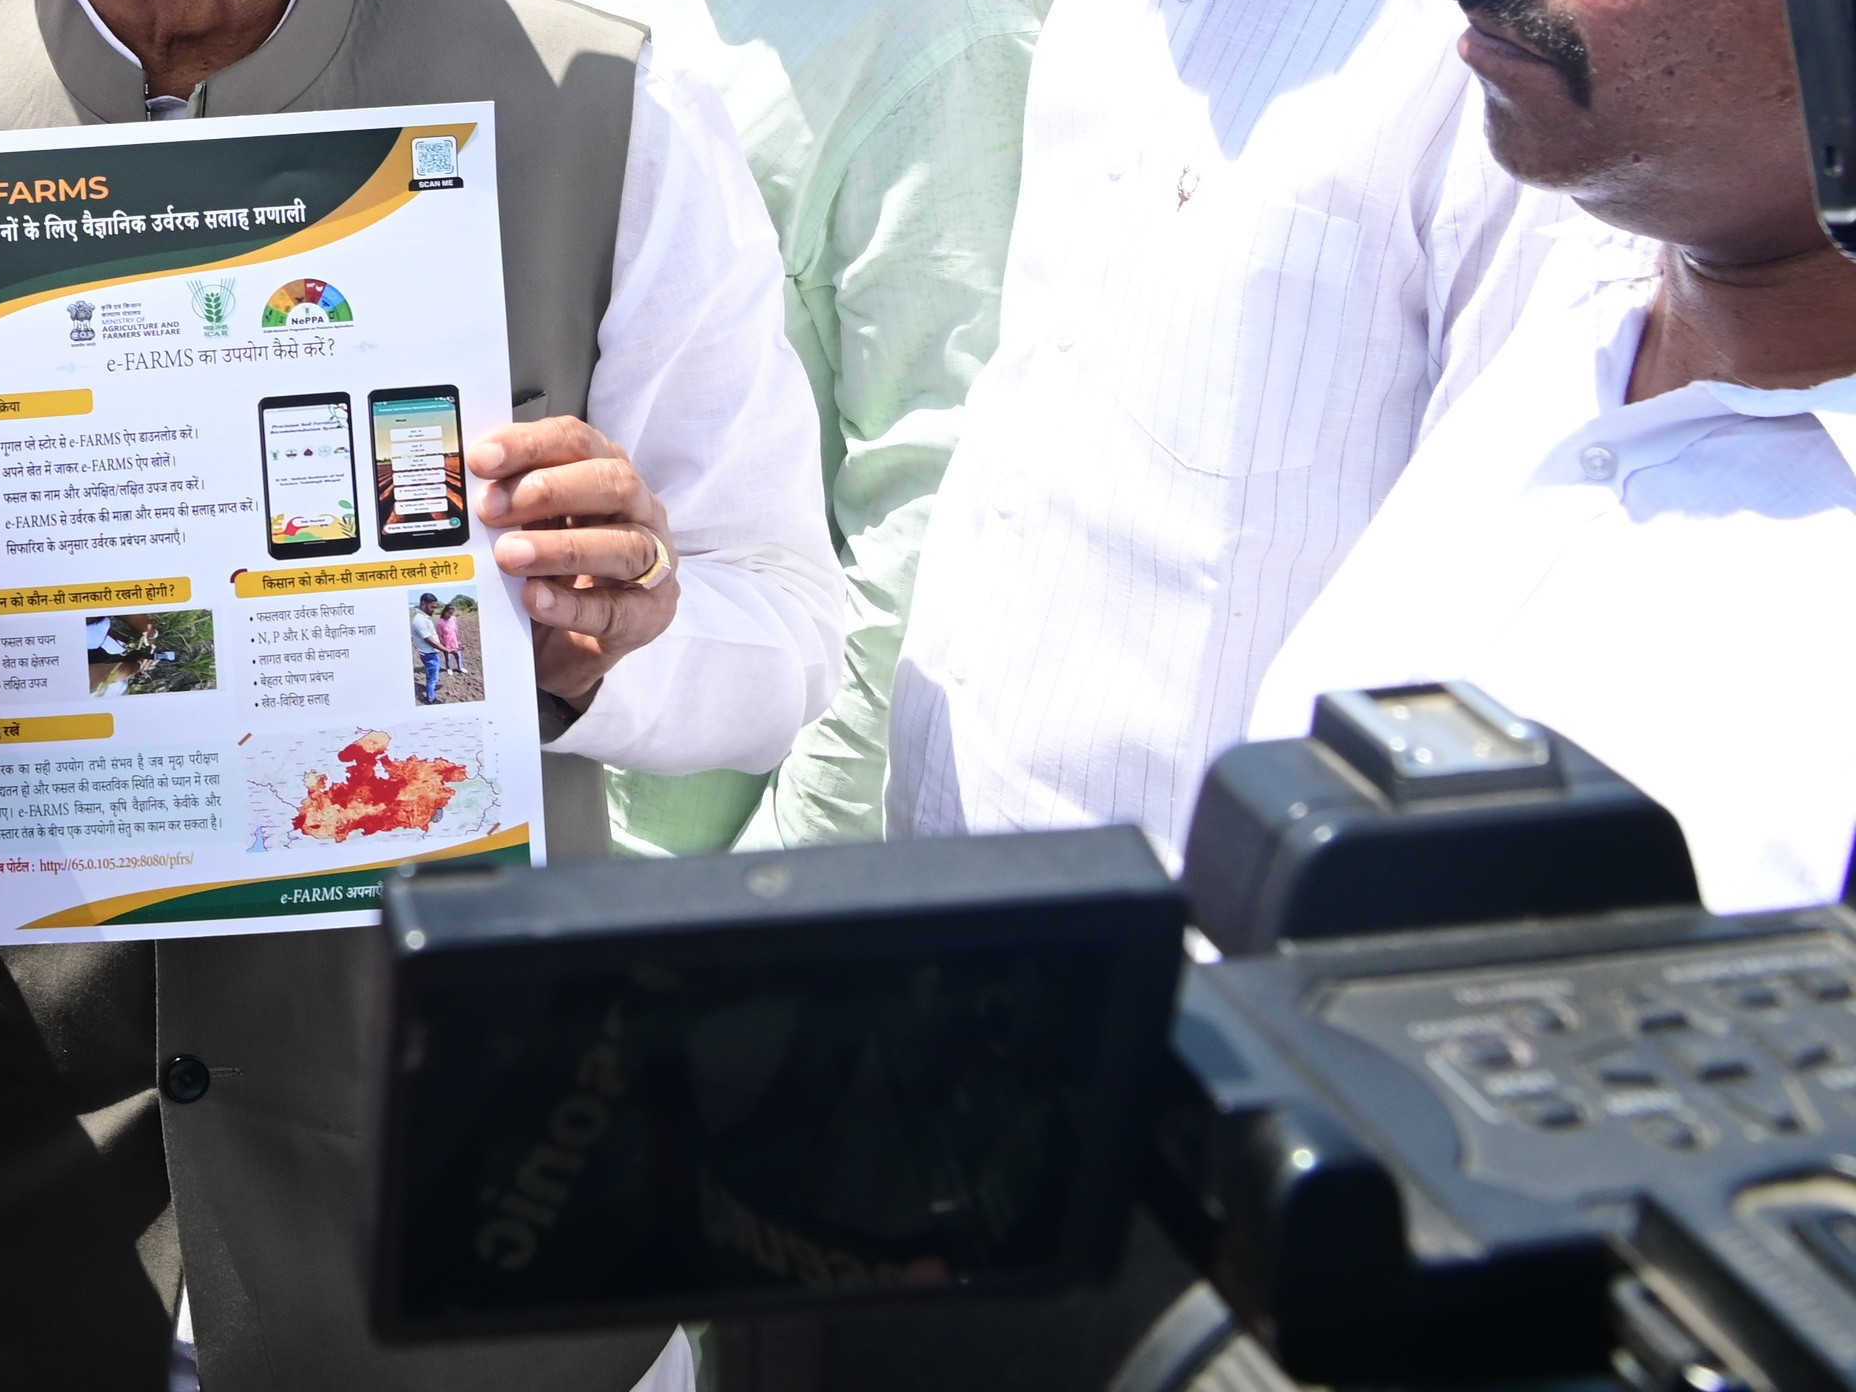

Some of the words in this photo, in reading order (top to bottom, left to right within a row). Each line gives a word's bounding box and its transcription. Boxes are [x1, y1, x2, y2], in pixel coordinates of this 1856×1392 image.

[418, 180, 441, 188] SCAN
[22, 214, 40, 240] के
[43, 213, 78, 241] लिए
[80, 209, 146, 239] वैज्ञानिक
[149, 204, 199, 232] उर्वरक
[202, 208, 250, 231] सलाह
[252, 197, 306, 225] प्रणाली
[101, 316, 135, 325] MINISTRY
[101, 322, 159, 332] AGRICULTURE
[160, 320, 180, 328] AND
[291, 315, 324, 325] NePPA
[102, 330, 141, 340] FARMERS
[142, 327, 181, 337] WELFARE
[203, 329, 229, 338] ICAR
[106, 347, 194, 372] e-FARMS
[196, 349, 217, 365] का
[219, 340, 269, 363] उपयोग
[271, 337, 300, 359] कैसे
[301, 335, 335, 357] करें?
[0, 440, 23, 457] गूगल
[22, 435, 36, 451] प्ले
[36, 434, 57, 451] स्टोर
[57, 433, 67, 449] से
[68, 431, 121, 448] e-FARMS
[122, 428, 137, 447] ऐप
[137, 425, 177, 443] डाउनलोड
[1, 461, 25, 478] अपने
[25, 460, 42, 476] खेत
[42, 459, 52, 475] में
[52, 462, 79, 474] जाकर
[80, 456, 133, 473] e-FARMS
[133, 453, 149, 471] ऐप
[2, 491, 28, 504] फसल
[28, 490, 42, 502] का
[42, 489, 61, 501] नाम
[62, 482, 80, 499] और
[81, 479, 145, 500] अपेक्षित/लक्षित
[145, 481, 168, 493] उपज
[168, 480, 183, 492] तय
[4, 513, 57, 529] e-FARMS
[58, 509, 68, 526] से
[68, 508, 96, 525] उर्वरक
[96, 506, 110, 523] की
[134, 503, 153, 520] और
[152, 506, 176, 519] समय
[176, 501, 189, 517] की
[190, 503, 216, 517] सलाह
[216, 502, 238, 514] प्राप्त
[5, 538, 45, 555] सिफारिश
[45, 536, 56, 552] के
[57, 538, 89, 555] अनुसार
[89, 532, 118, 549] उर्वरक
[118, 532, 147, 547] प्रबंधन
[261, 574, 295, 590] किसान
[297, 571, 312, 587] को
[313, 568, 352, 586] कौन-सी
[354, 564, 398, 582] जानकारी
[399, 562, 427, 579] रखनी
[428, 561, 458, 579] होगी?
[9, 591, 24, 607] को
[25, 589, 66, 606] कौन-सी
[67, 586, 112, 603] जानकारी
[113, 583, 143, 600] रखनी
[144, 582, 175, 601] होगी?
[255, 609, 292, 622] फसलवार
[292, 604, 319, 619] उर्वरक
[319, 602, 354, 618] सिफारिश
[0, 636, 23, 648] फसल
[23, 635, 36, 646] का
[35, 634, 56, 646] चयन
[257, 631, 271, 645] N,
[272, 630, 280, 643] P
[282, 626, 299, 642] और
[300, 628, 310, 641] K
[310, 625, 323, 639] की
[322, 623, 356, 640] वैज्ञानिक
[305, 693, 330, 706] सलाह
[1, 721, 20, 737] रखें
[17, 763, 31, 775] का
[33, 758, 51, 776] सही
[54, 756, 84, 772] उपयोग
[87, 755, 106, 771] तभी
[110, 756, 133, 770] संभव
[136, 752, 145, 771] है
[147, 755, 164, 768] जब
[167, 754, 185, 770] मृदा
[187, 749, 219, 767] परीक्षण
[19, 780, 31, 798] हो
[31, 778, 50, 795] और
[50, 782, 76, 794] फसल
[76, 777, 89, 793] की
[90, 776, 130, 792] वास्तविक
[130, 774, 155, 791] स्थिति
[155, 772, 169, 788] को
[170, 775, 192, 787] ध्यान
[192, 770, 202, 786] में
[202, 774, 220, 785] रखा
[17, 802, 70, 817] e-FARMS
[73, 799, 105, 816] किसान,
[108, 797, 127, 817] कृषि
[131, 795, 169, 813] वैज्ञानिक,
[171, 792, 200, 809] केवीके
[204, 790, 221, 807] और
[35, 822, 47, 838] के
[46, 822, 65, 837] बीच
[65, 824, 83, 839] एक
[82, 819, 116, 835] उपयोगी
[116, 818, 132, 838] सेतु
[132, 821, 145, 833] का
[146, 820, 167, 832] काम
[166, 819, 182, 831] कर
[182, 818, 209, 830] सकता
[4, 856, 30, 873] पोर्टल
